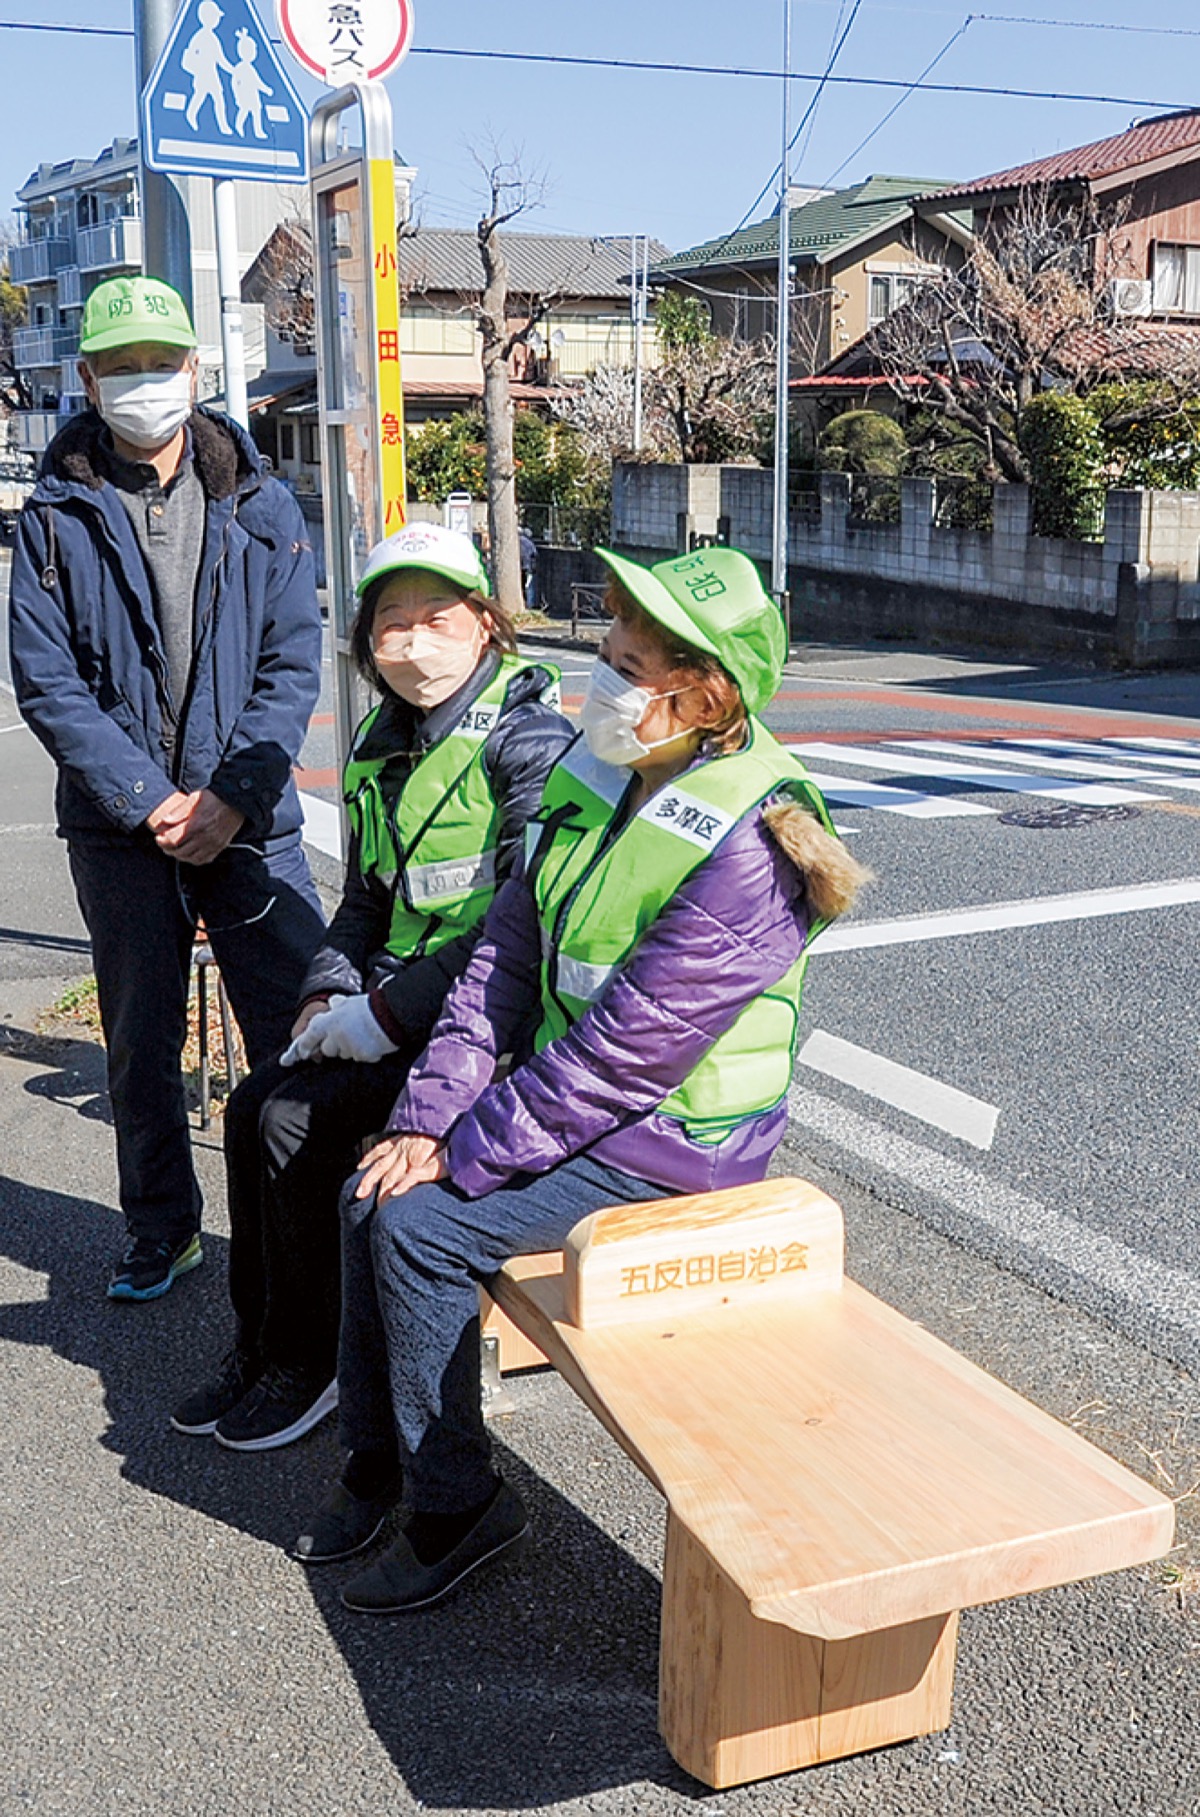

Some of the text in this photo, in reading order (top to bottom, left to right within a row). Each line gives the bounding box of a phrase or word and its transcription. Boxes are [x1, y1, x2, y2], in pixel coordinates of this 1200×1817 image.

[328, 0, 364, 67] 急バス
[108, 293, 170, 319] 防犯
[655, 797, 723, 840] 多摩区
[619, 1241, 808, 1297] 五反田自治会
